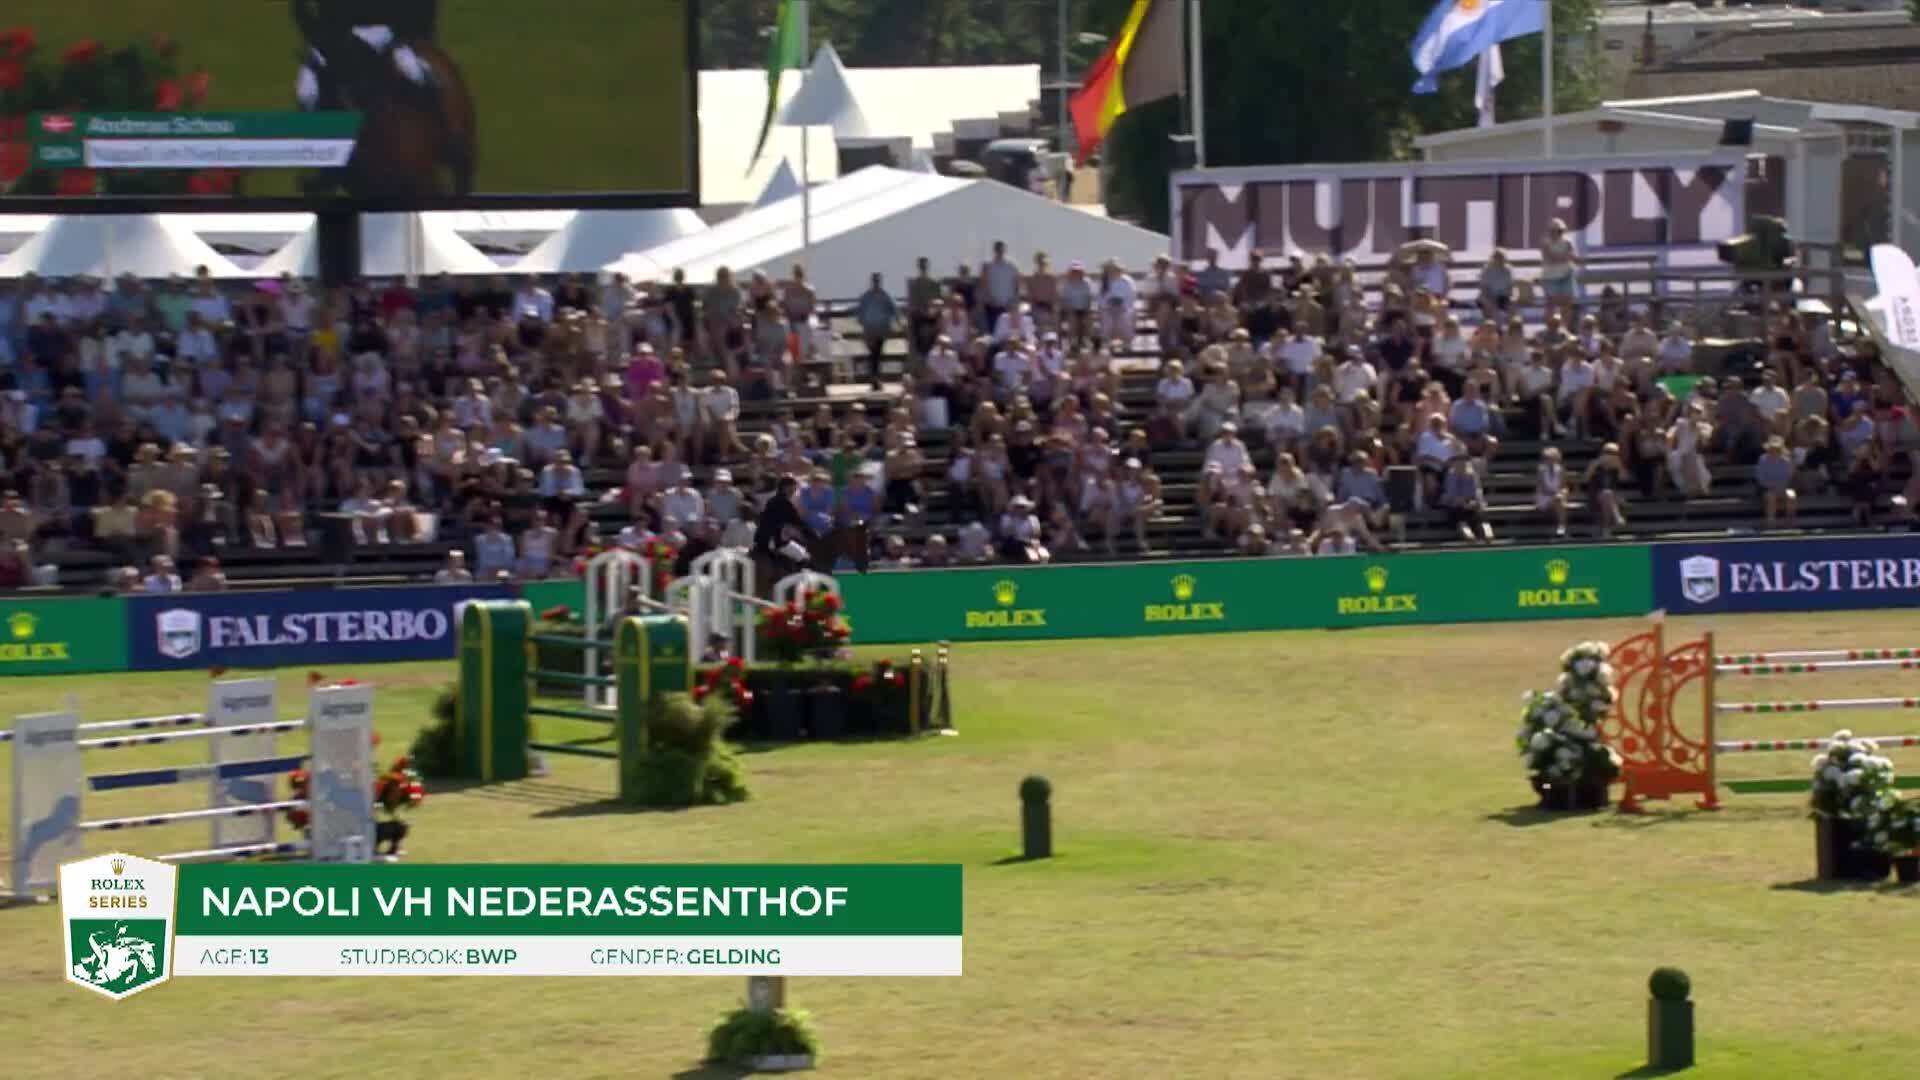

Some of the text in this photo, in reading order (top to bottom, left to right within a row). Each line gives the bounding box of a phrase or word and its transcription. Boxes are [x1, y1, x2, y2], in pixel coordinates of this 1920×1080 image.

[1181, 166, 1735, 260] MULTIPLY
[1337, 594, 1418, 614] ROLEX
[1518, 587, 1599, 607] ROLEX
[965, 609, 1047, 628] ROLEX
[1144, 602, 1225, 622] ROLEX
[209, 608, 448, 648] FALSTERBO
